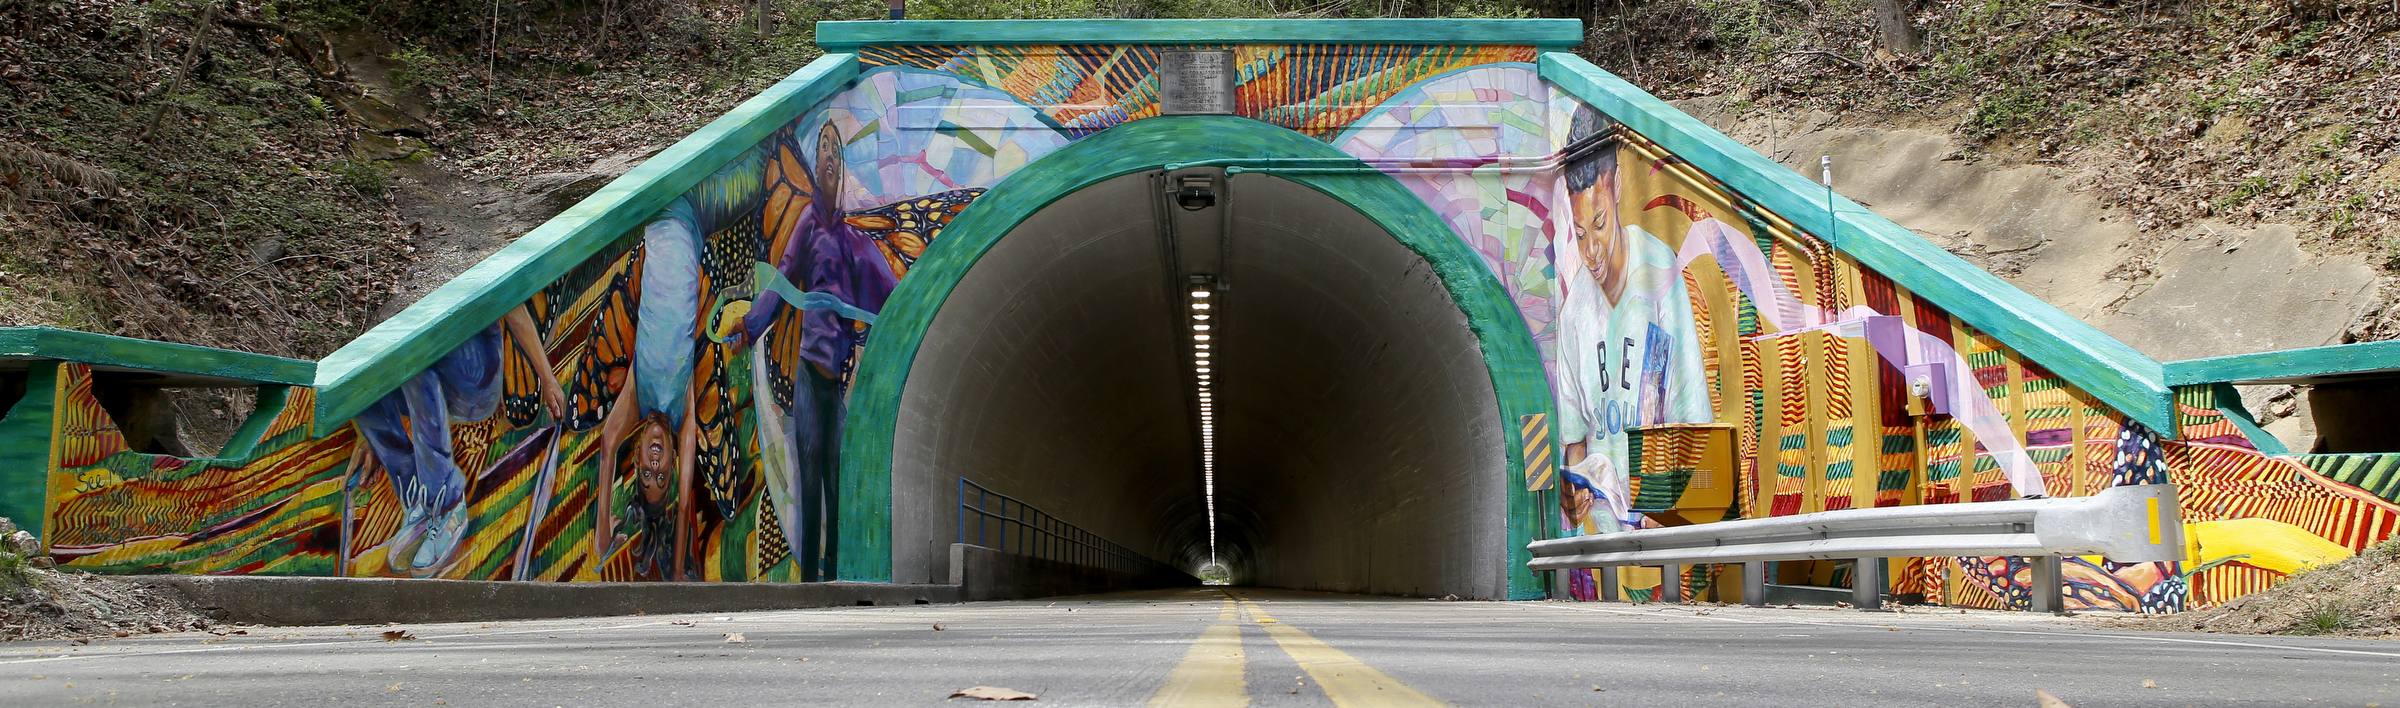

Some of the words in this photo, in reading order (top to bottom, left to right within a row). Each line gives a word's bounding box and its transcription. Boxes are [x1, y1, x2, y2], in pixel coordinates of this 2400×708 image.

[1596, 337, 1635, 393] BE
[74, 472, 106, 494] See
[108, 464, 130, 485] Me
